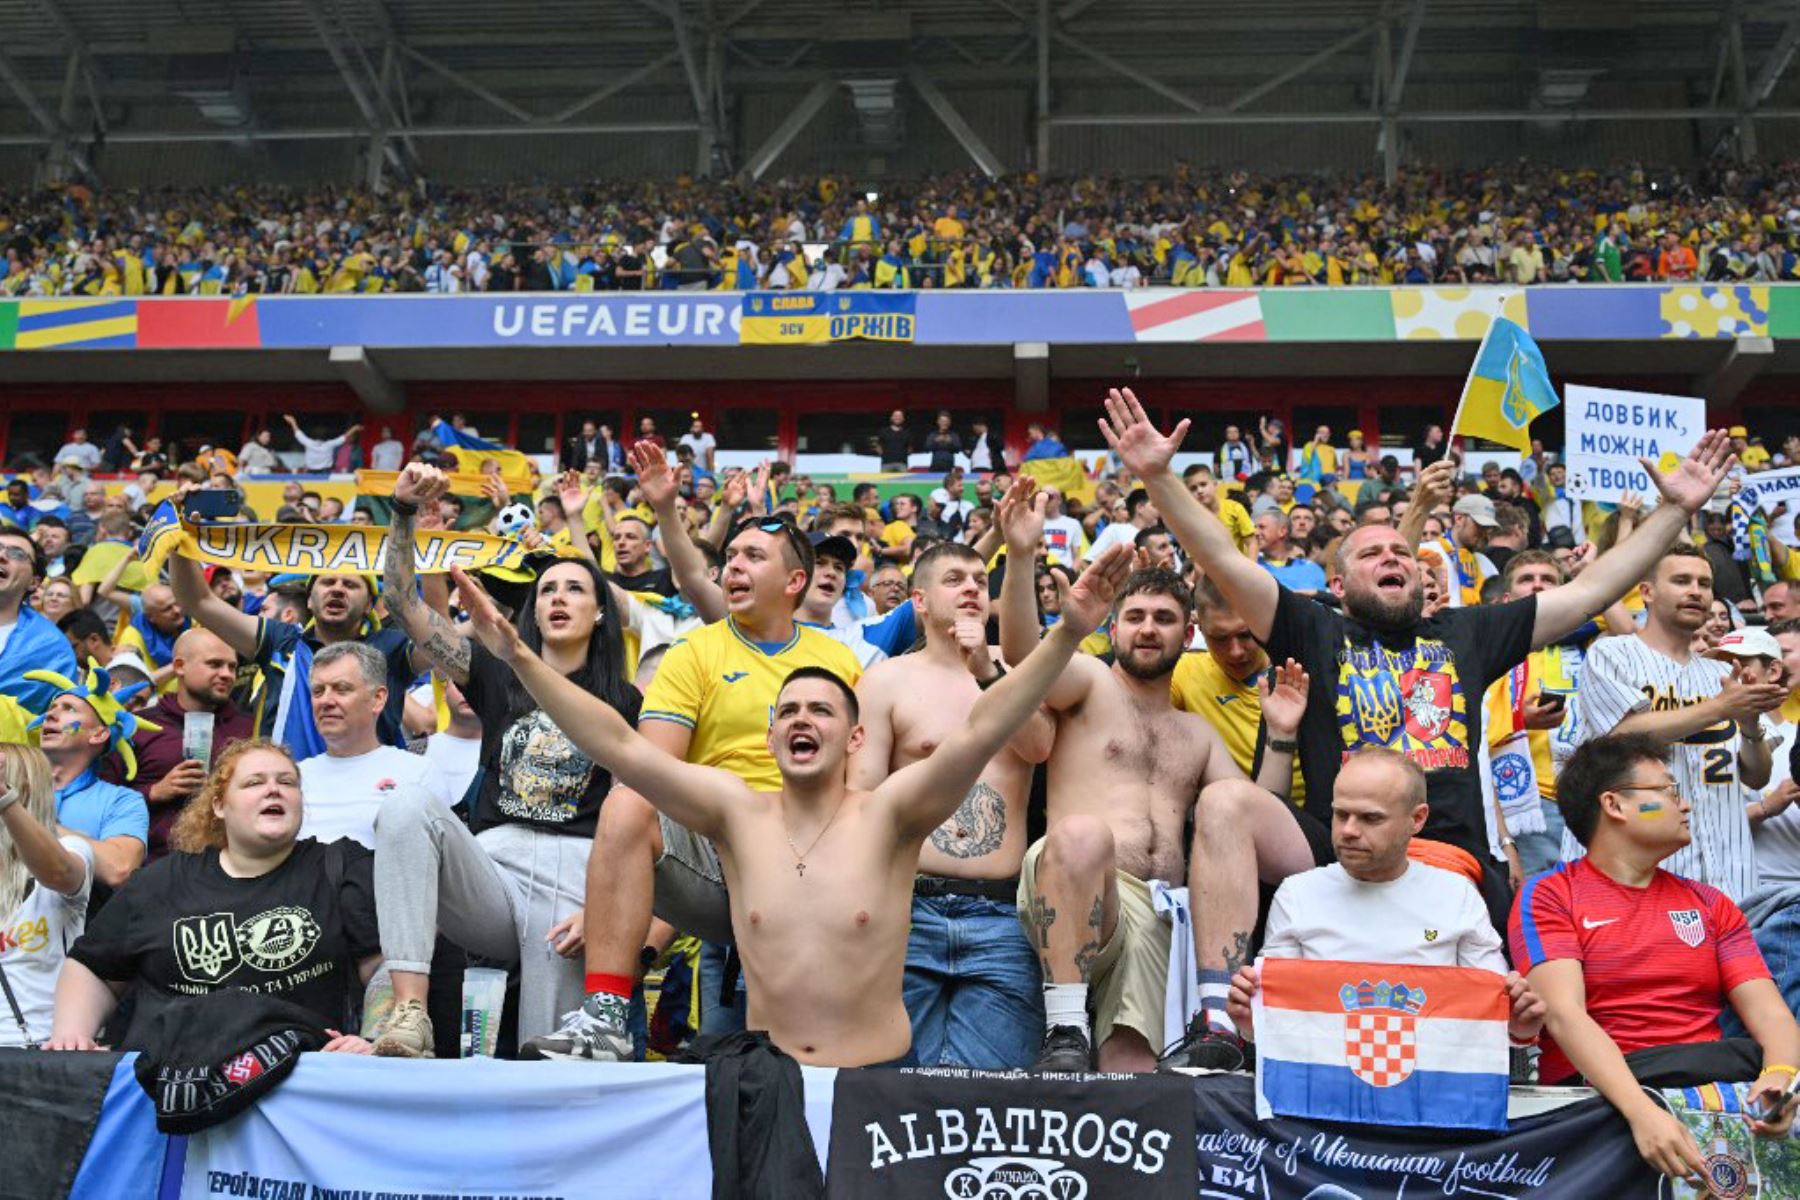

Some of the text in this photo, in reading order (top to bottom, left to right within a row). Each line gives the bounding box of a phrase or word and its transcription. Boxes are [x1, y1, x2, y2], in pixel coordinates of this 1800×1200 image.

[830, 314, 911, 338] ОРЖІВ
[1585, 402, 1688, 436] ДОВБИК,
[1581, 433, 1660, 458] МОЖНА
[1588, 467, 1648, 491] ТВОЮ
[1703, 748, 1734, 784] 2
[1670, 909, 1699, 926] USA
[864, 1107, 1172, 1175] ALBATROSS
[1196, 1128, 1557, 1195] avery of Ukrainian football
[994, 1170, 1039, 1184] DYNAMO
